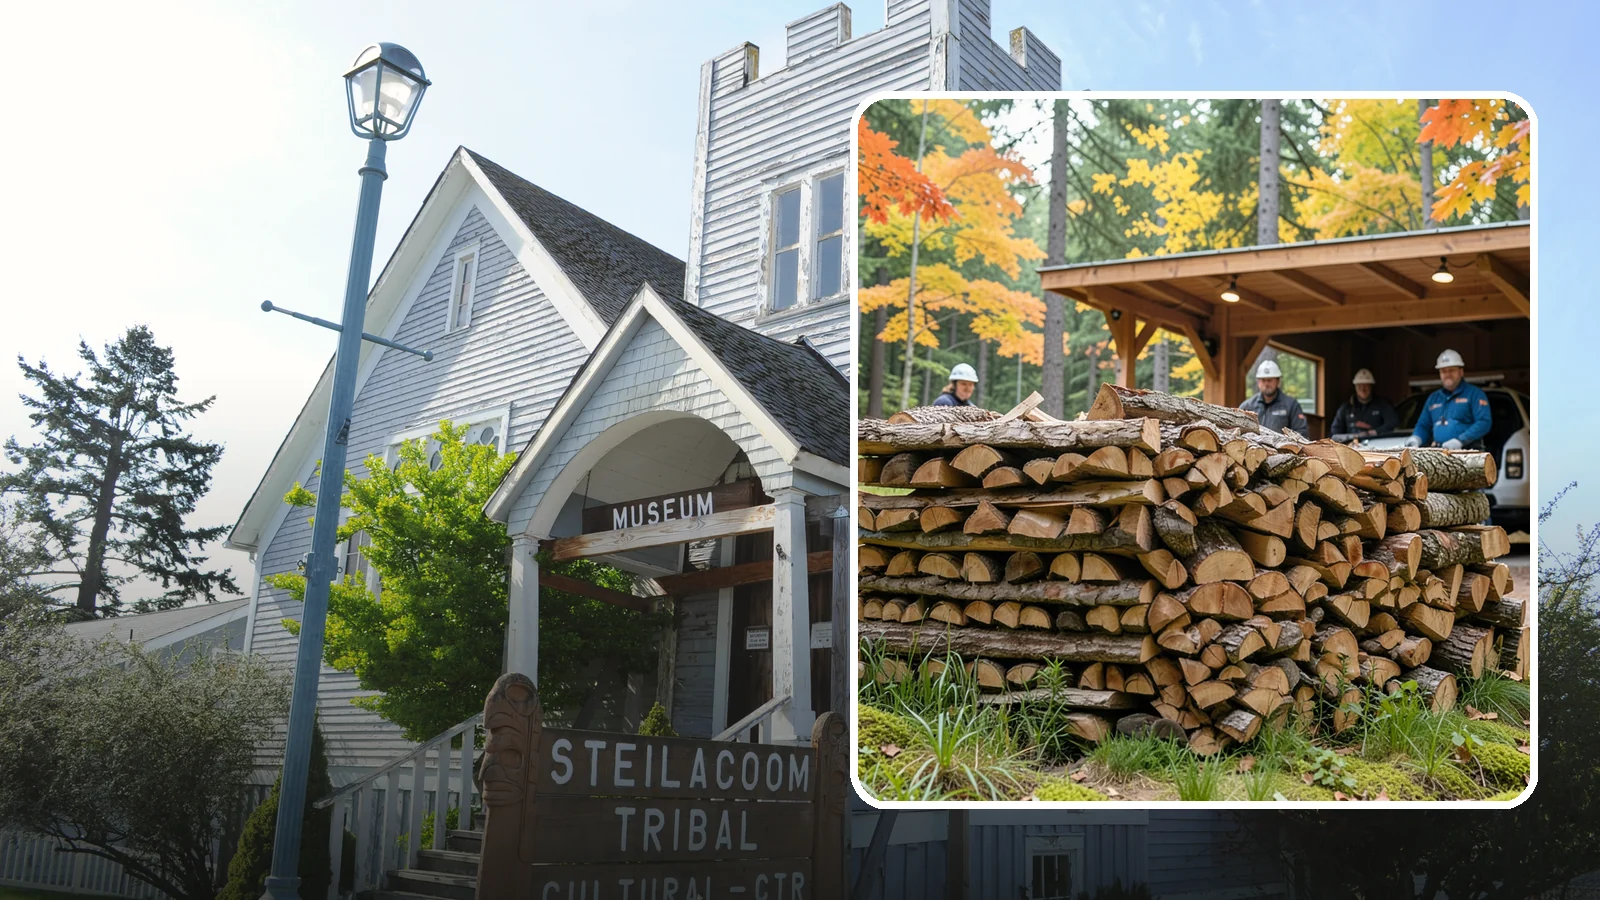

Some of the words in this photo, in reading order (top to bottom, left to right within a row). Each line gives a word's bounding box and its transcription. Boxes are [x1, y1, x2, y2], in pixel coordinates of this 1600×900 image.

[612, 491, 714, 531] MUSEUM
[550, 738, 810, 793] STEILACOOM
[614, 806, 758, 853] TRIBAL
